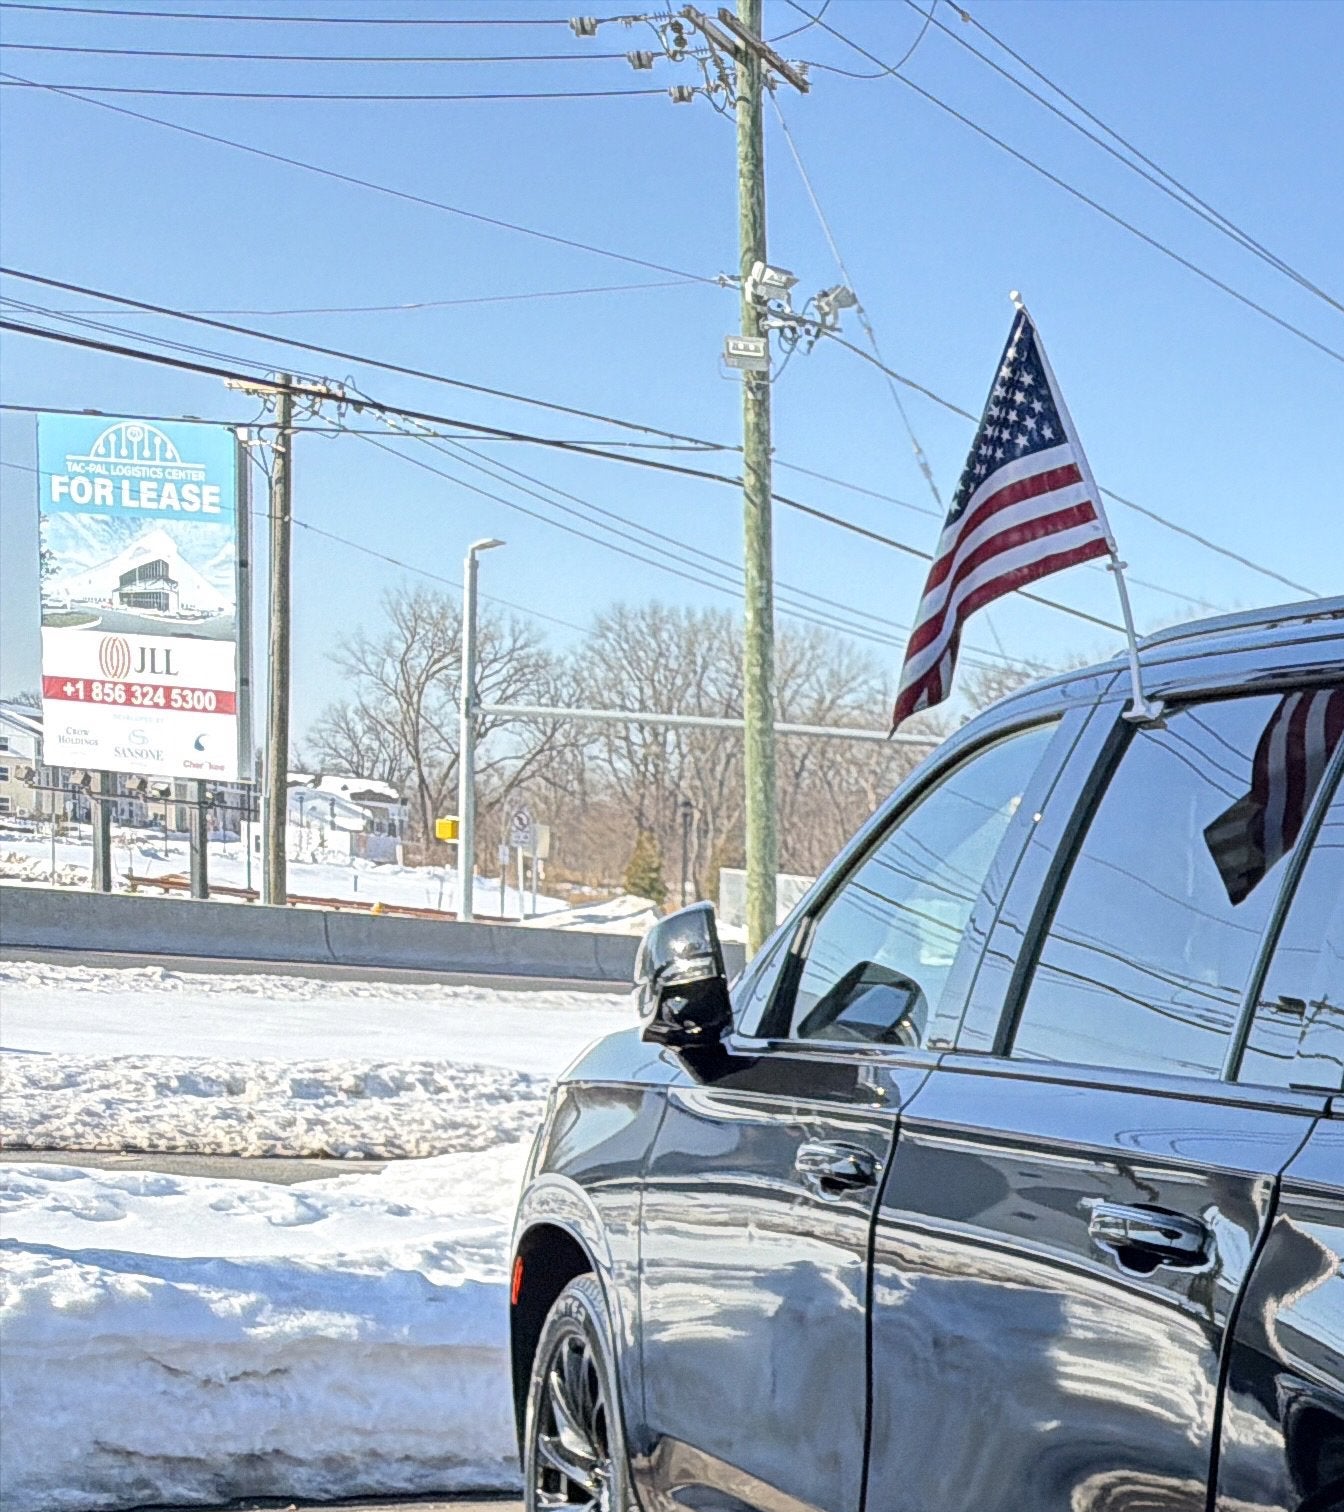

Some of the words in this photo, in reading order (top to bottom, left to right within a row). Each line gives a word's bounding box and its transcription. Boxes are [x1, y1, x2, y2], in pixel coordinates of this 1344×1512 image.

[66, 461, 109, 474] TAC-PAL
[111, 465, 163, 479] LOGISTICS
[165, 468, 206, 481] CENTER
[51, 474, 114, 507] FOR
[121, 479, 221, 514] LEASE
[134, 646, 179, 676] JLL
[63, 680, 85, 700] +1
[91, 682, 126, 704] 856
[131, 686, 165, 708] 324
[170, 689, 217, 711] 5300
[58, 734, 99, 746] HOLDINGS
[114, 746, 164, 762] SANSONE
[183, 760, 225, 771] Cherkee
